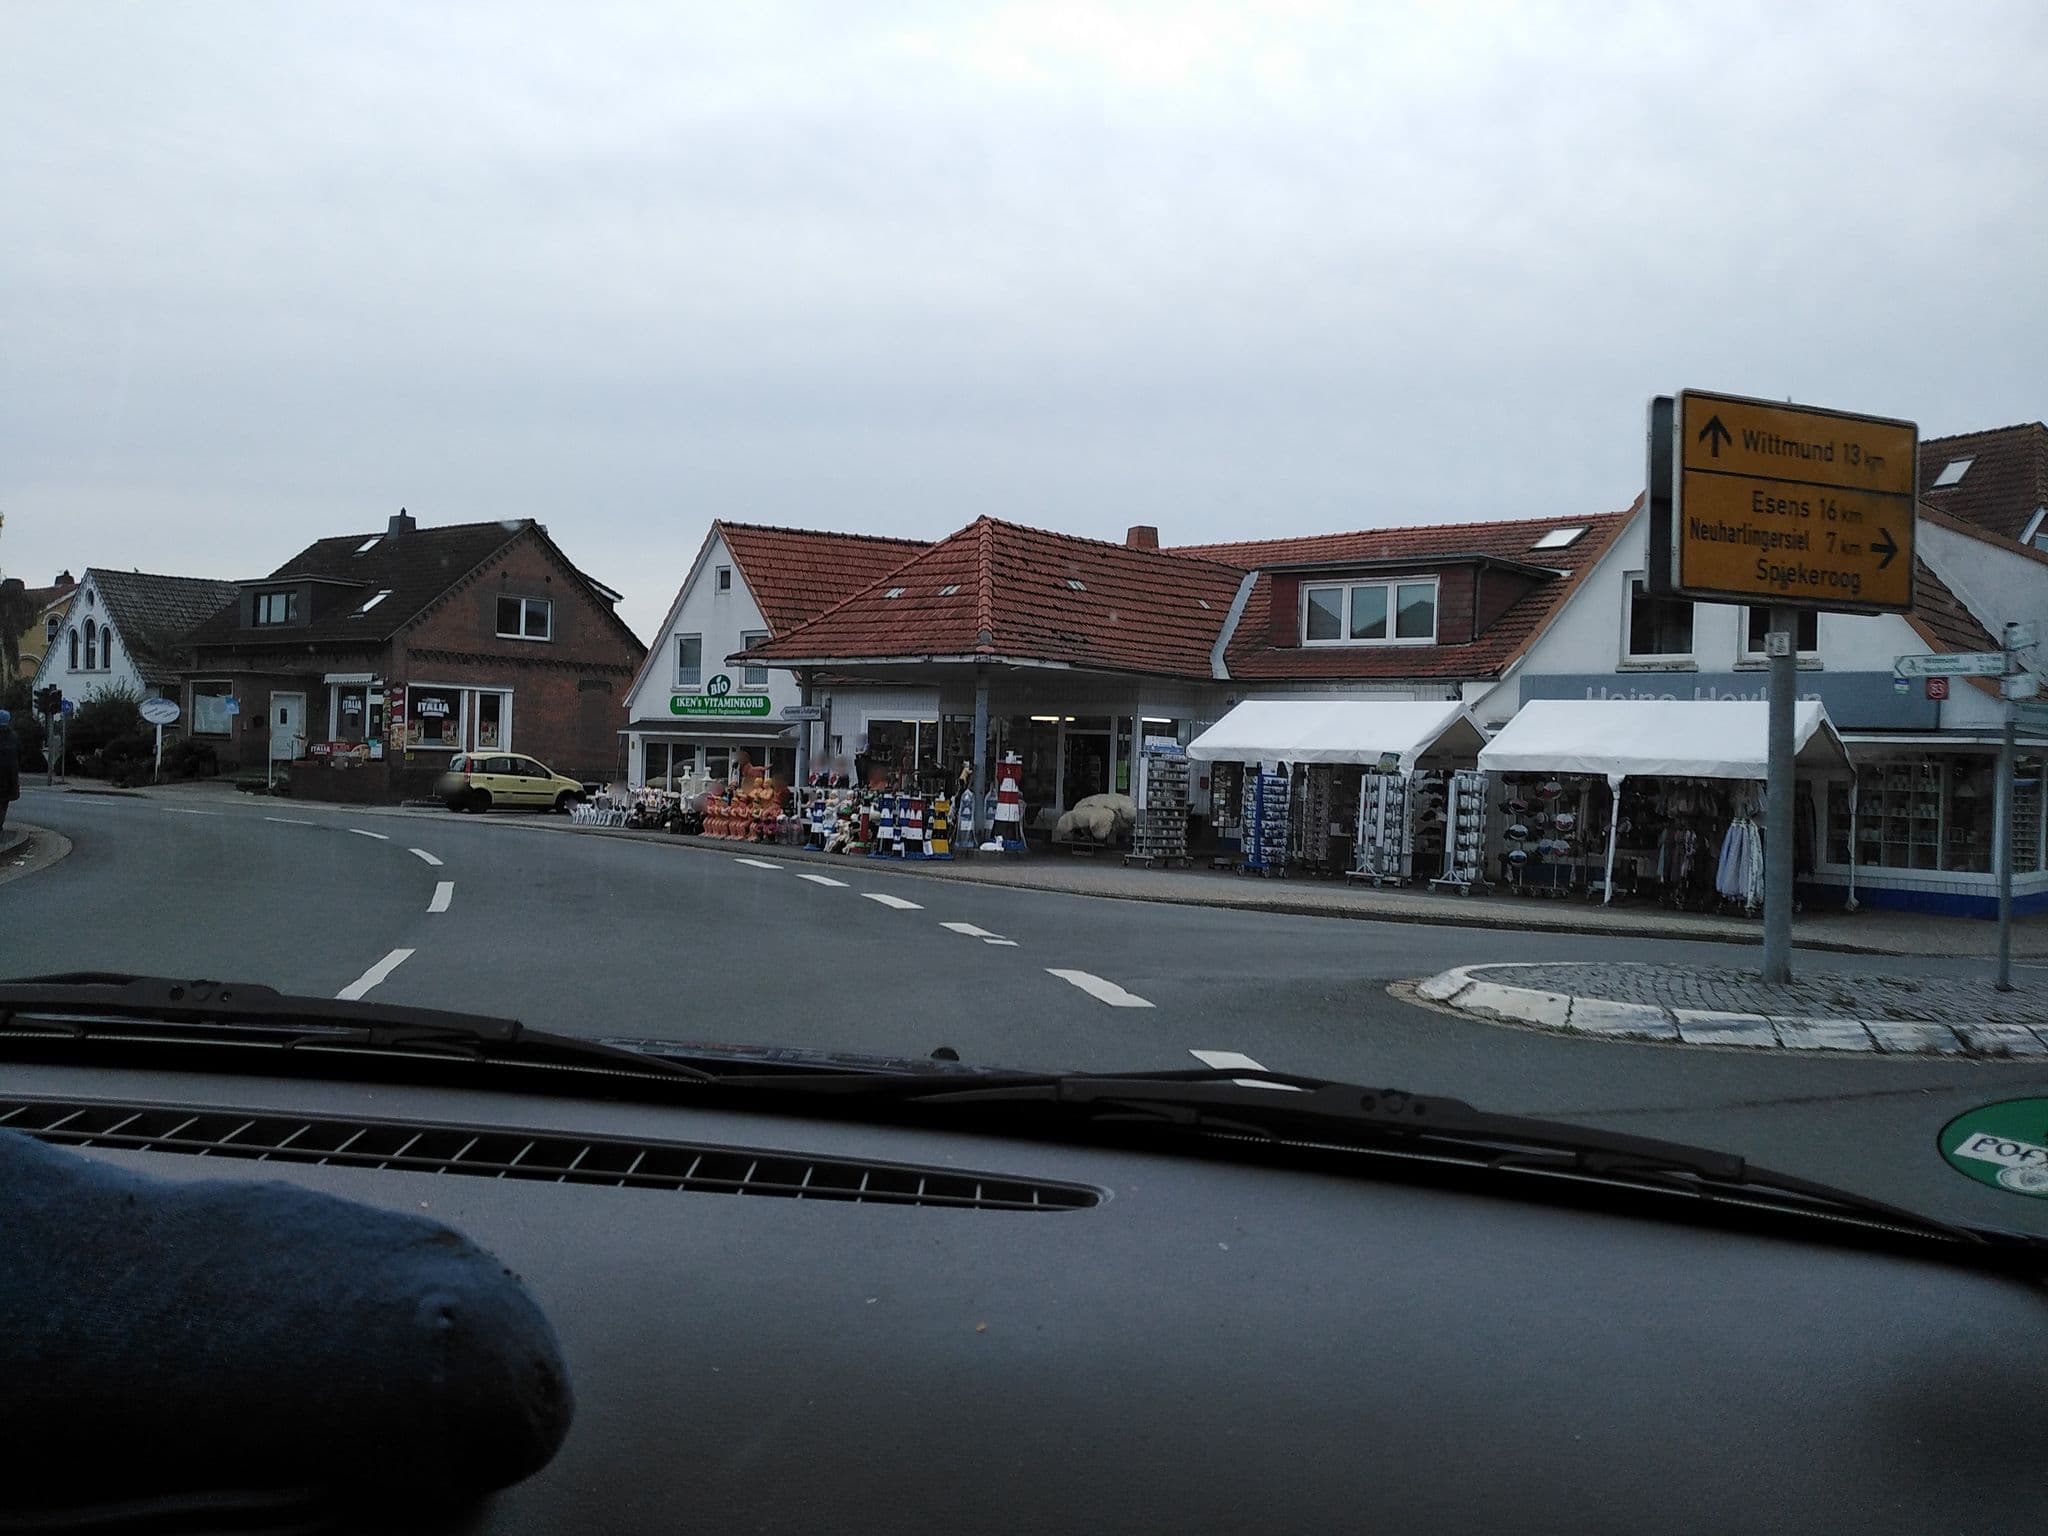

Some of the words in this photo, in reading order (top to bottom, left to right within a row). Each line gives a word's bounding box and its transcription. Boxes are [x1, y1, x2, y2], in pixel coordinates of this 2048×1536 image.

[1742, 428, 1834, 463] Wittmund
[1843, 442, 1861, 466] 13
[1751, 489, 1810, 518] Esens
[1820, 498, 1838, 521] 16
[1841, 508, 1863, 523] km
[1689, 516, 1811, 553] Neuharlingersiel
[1825, 531, 1838, 553] 7
[1755, 558, 1862, 595] Spiekeroog
[342, 700, 362, 711] ITALIA
[417, 702, 450, 714] ITALIA
[704, 697, 764, 708] VITAMINKORB
[311, 745, 330, 753] ITALIA
